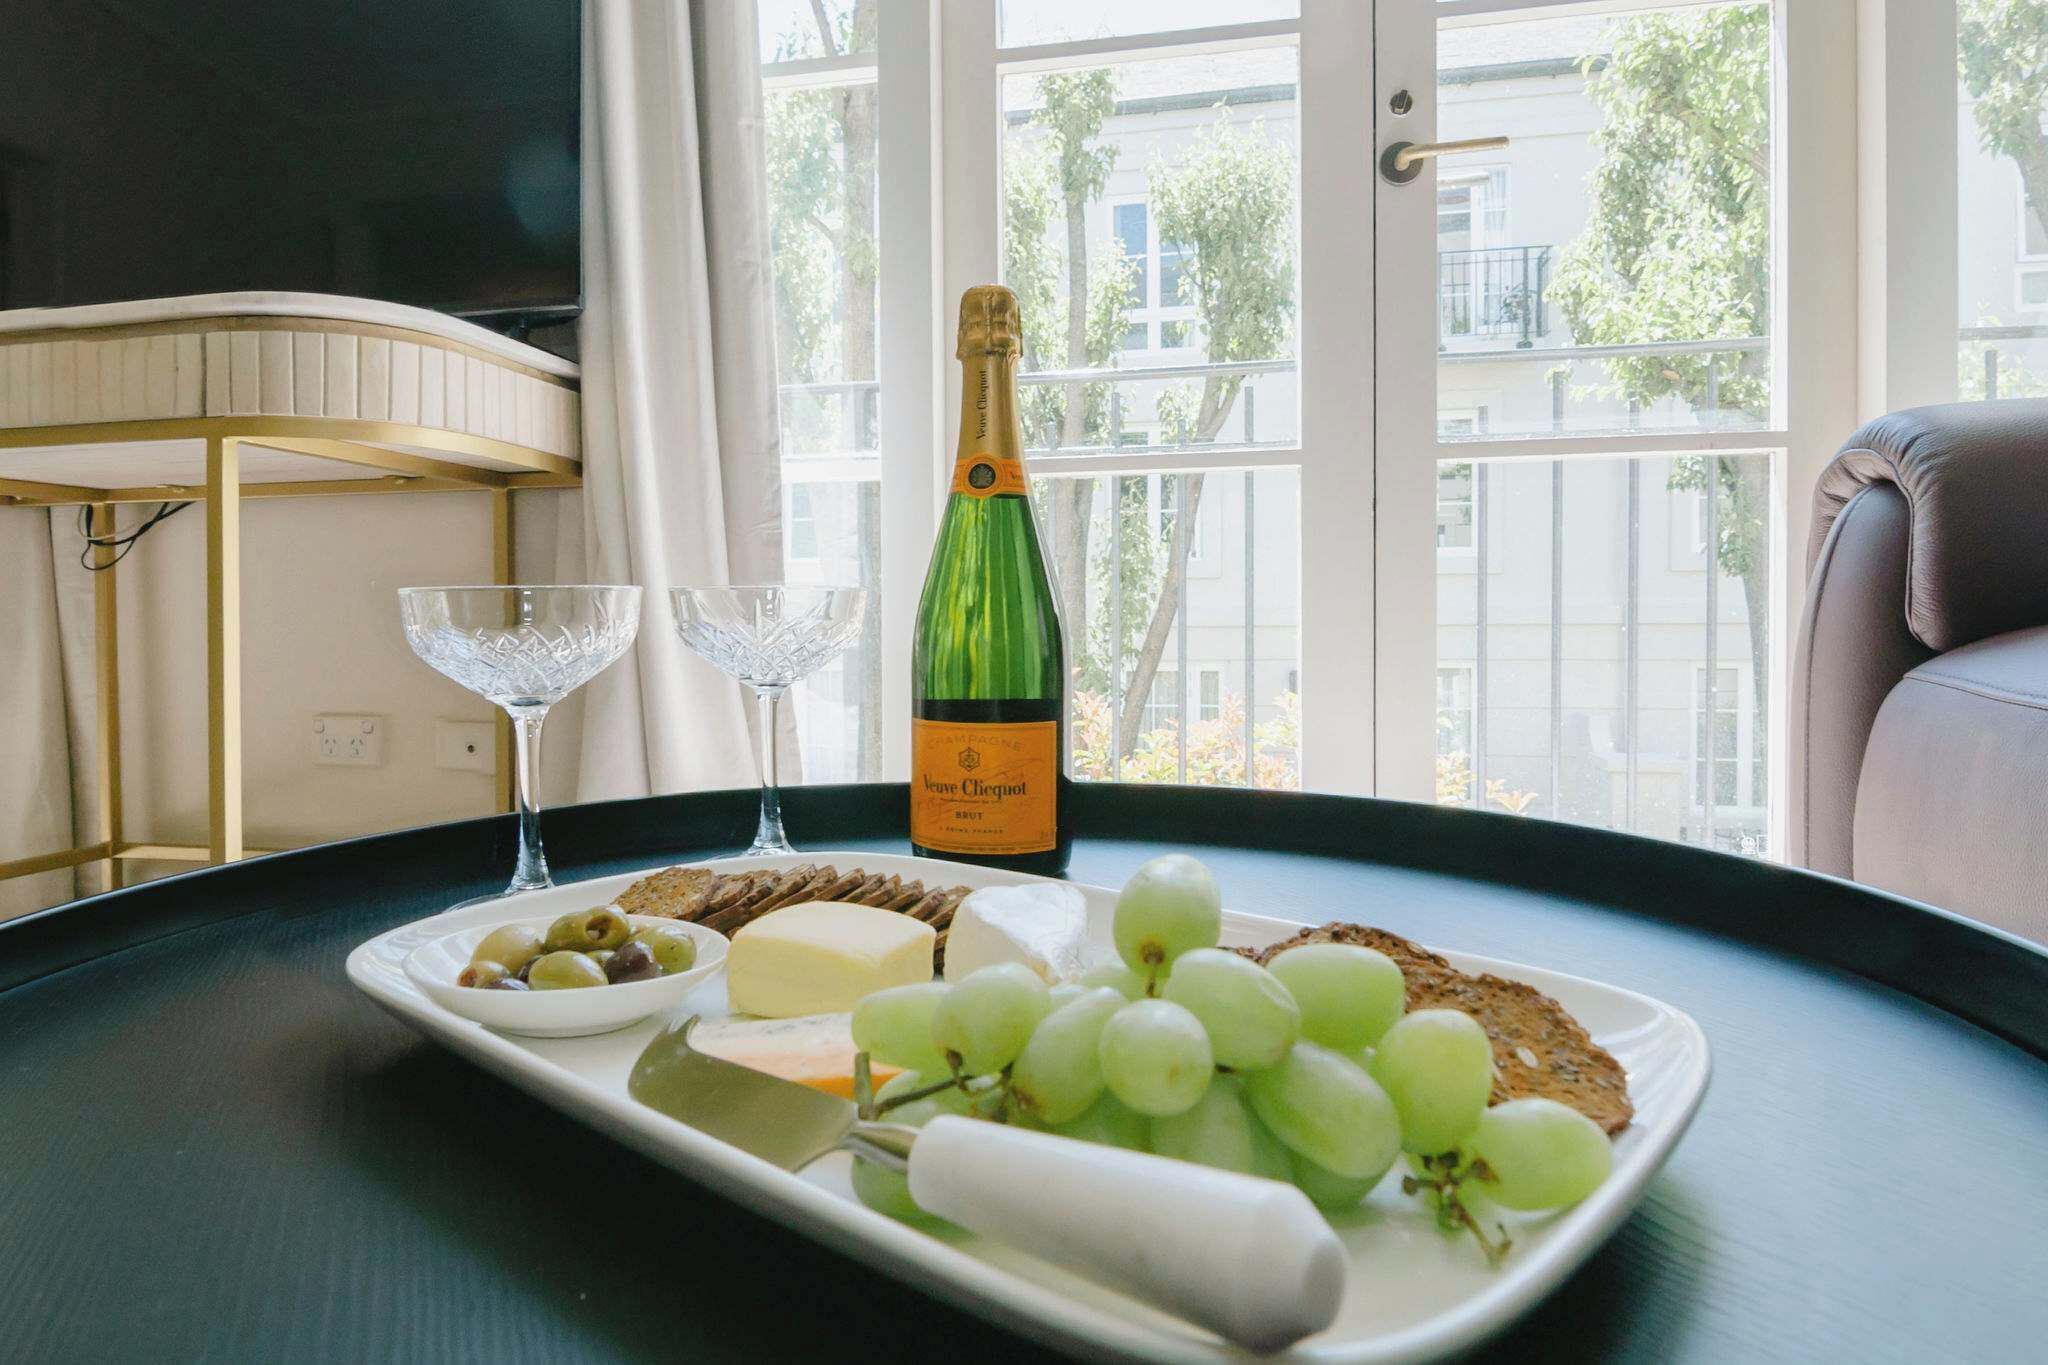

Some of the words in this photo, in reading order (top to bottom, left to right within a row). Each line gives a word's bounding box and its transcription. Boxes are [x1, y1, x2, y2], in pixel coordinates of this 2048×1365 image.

[976, 370, 989, 410] Clicquot
[976, 412, 987, 439] Veuve
[927, 734, 1024, 752] CHAMPAGNE
[923, 773, 958, 794] Veuve
[961, 777, 1026, 800] Clicquot
[955, 811, 984, 820] BRUT
